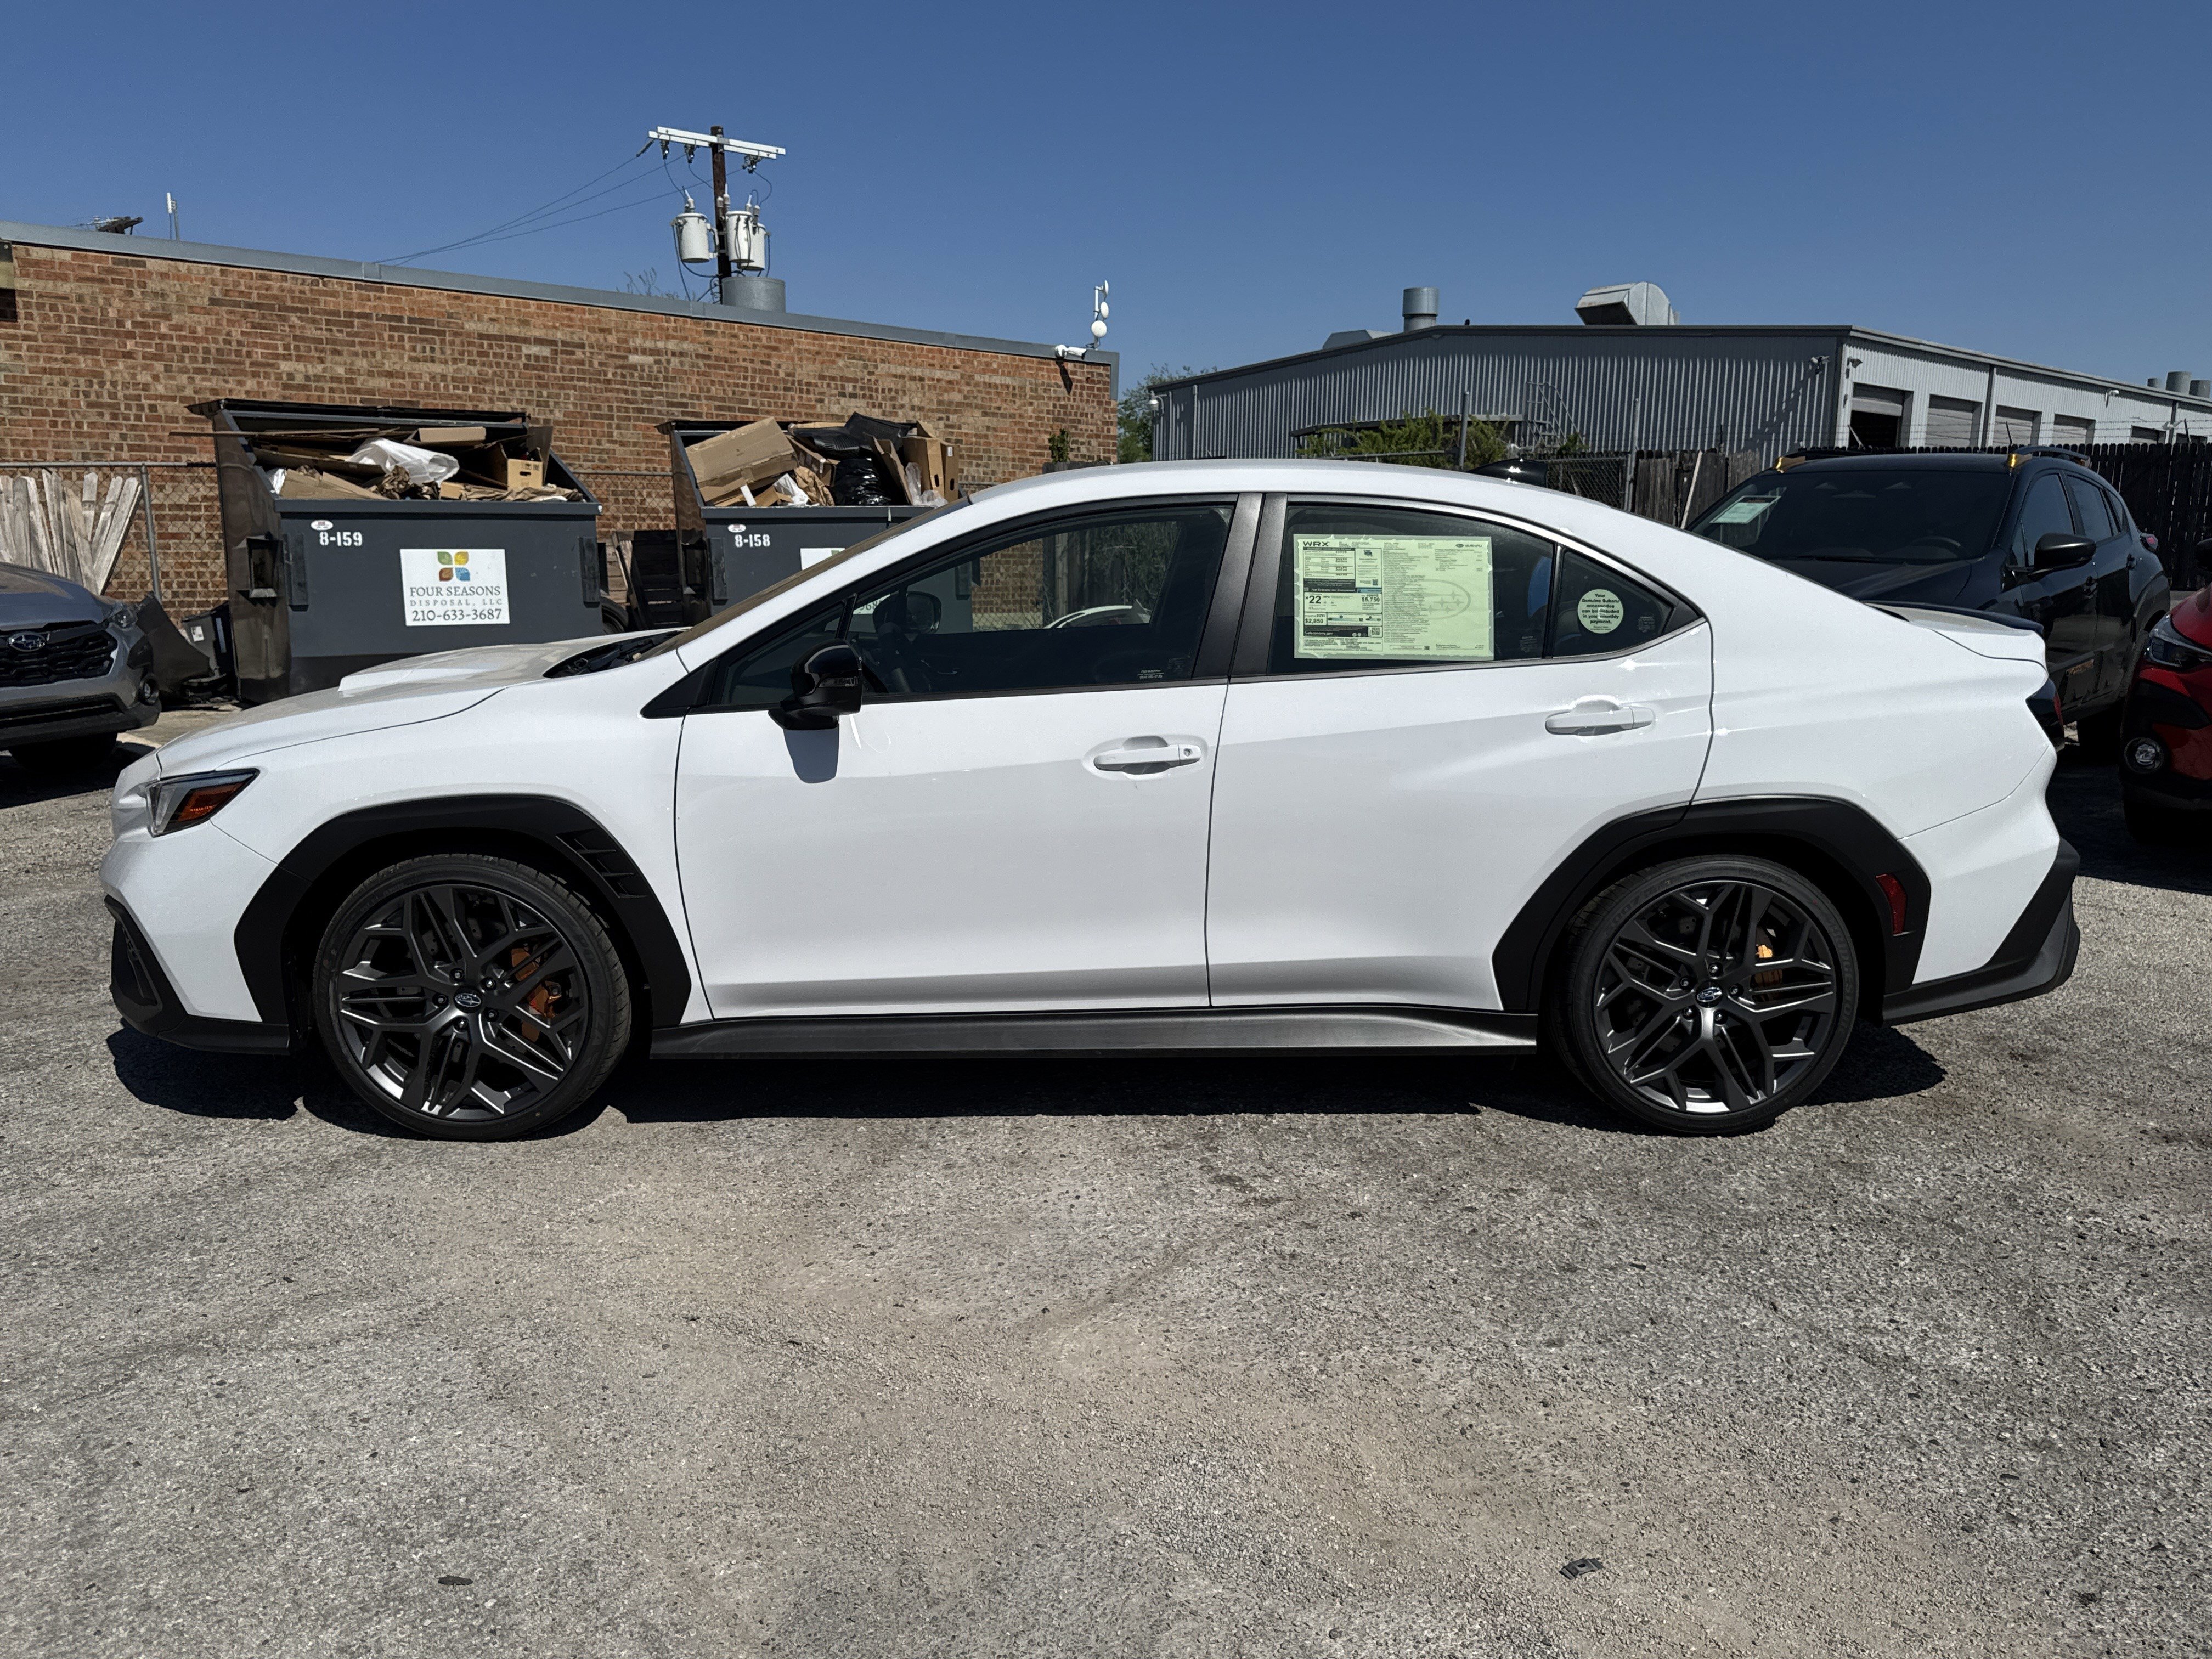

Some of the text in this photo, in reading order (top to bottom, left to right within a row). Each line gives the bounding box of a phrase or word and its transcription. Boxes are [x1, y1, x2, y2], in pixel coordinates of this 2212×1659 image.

[320, 531, 363, 546] 8-159
[735, 534, 771, 548] 8-158
[410, 586, 500, 597] FOUR SEASONS
[410, 599, 476, 607] DISPOSAL,
[1309, 595, 1321, 604] 22
[412, 608, 502, 622] 210-633-3687
